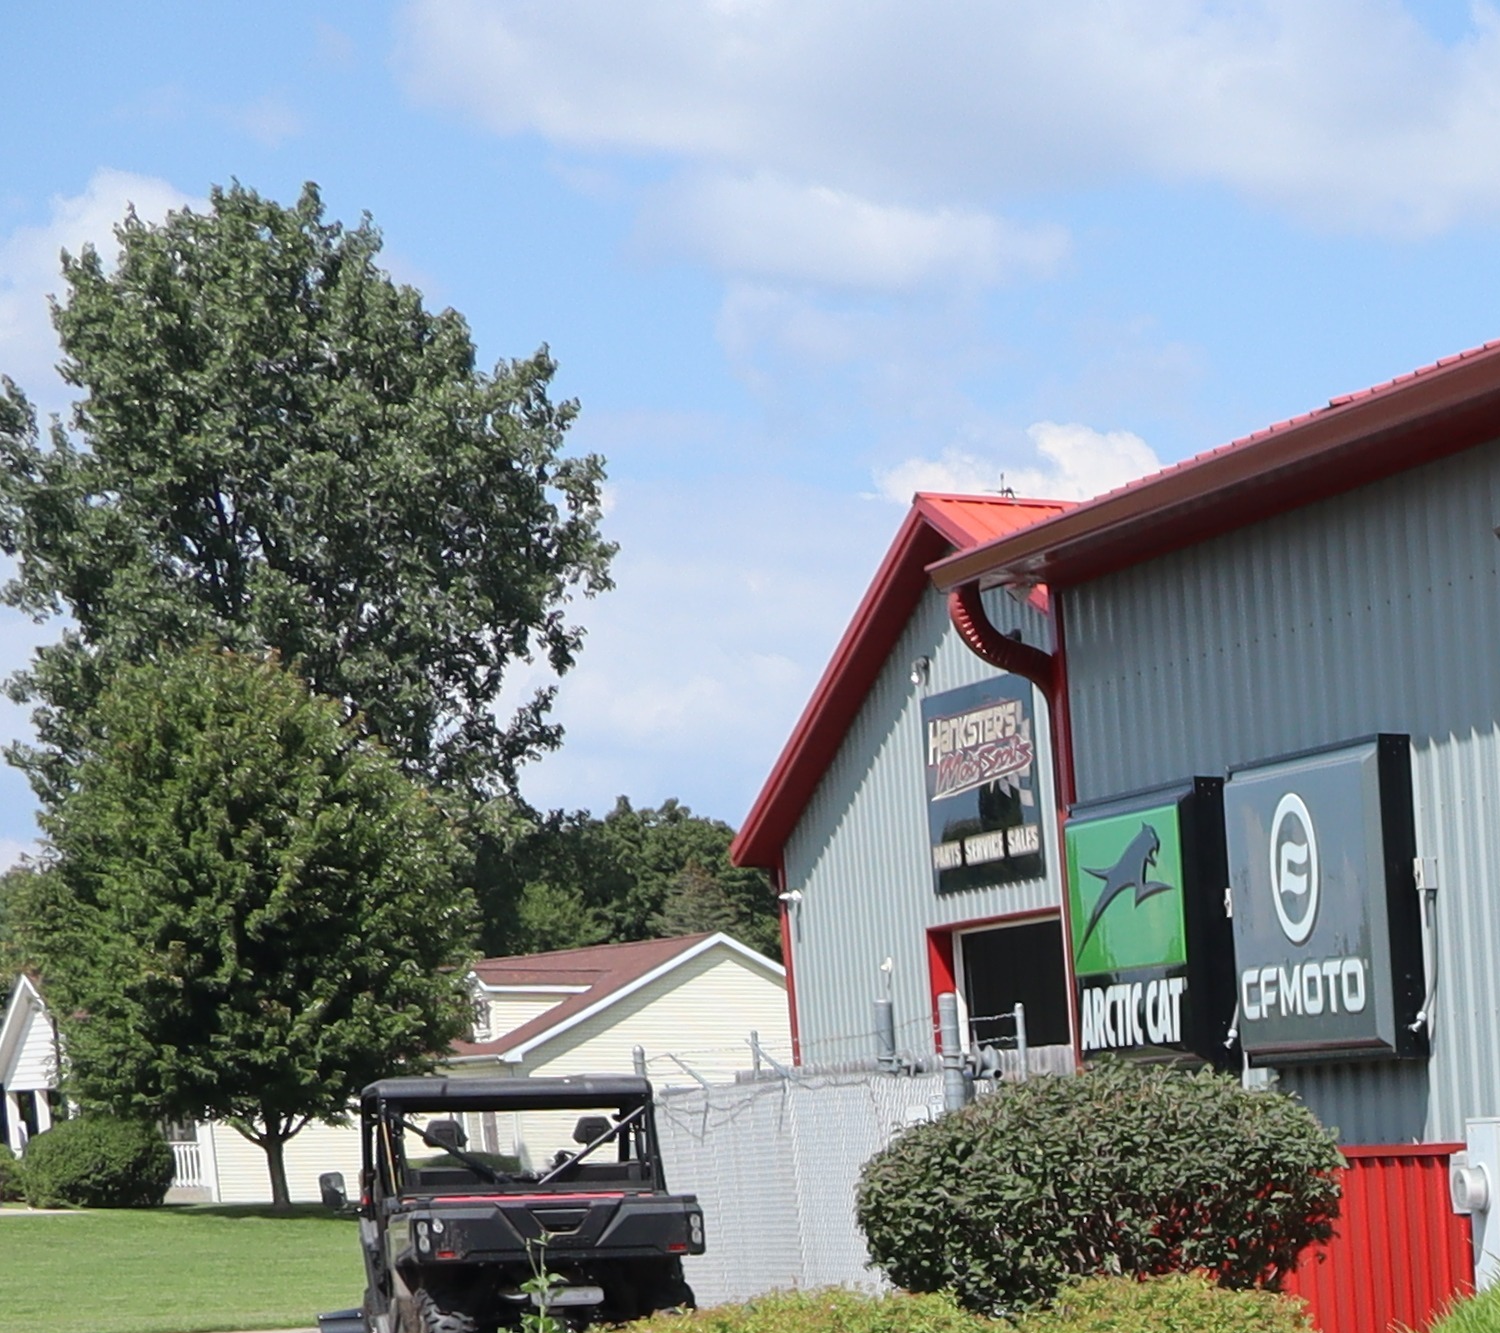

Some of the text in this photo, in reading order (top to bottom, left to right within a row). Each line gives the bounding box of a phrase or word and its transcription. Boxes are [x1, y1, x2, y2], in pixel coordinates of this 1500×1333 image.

[965, 831, 1004, 865] SERVICE
[1008, 826, 1040, 860] SALES
[1081, 977, 1185, 1050] ARCTIC CAT
[1242, 958, 1365, 1020] CFMOTO
